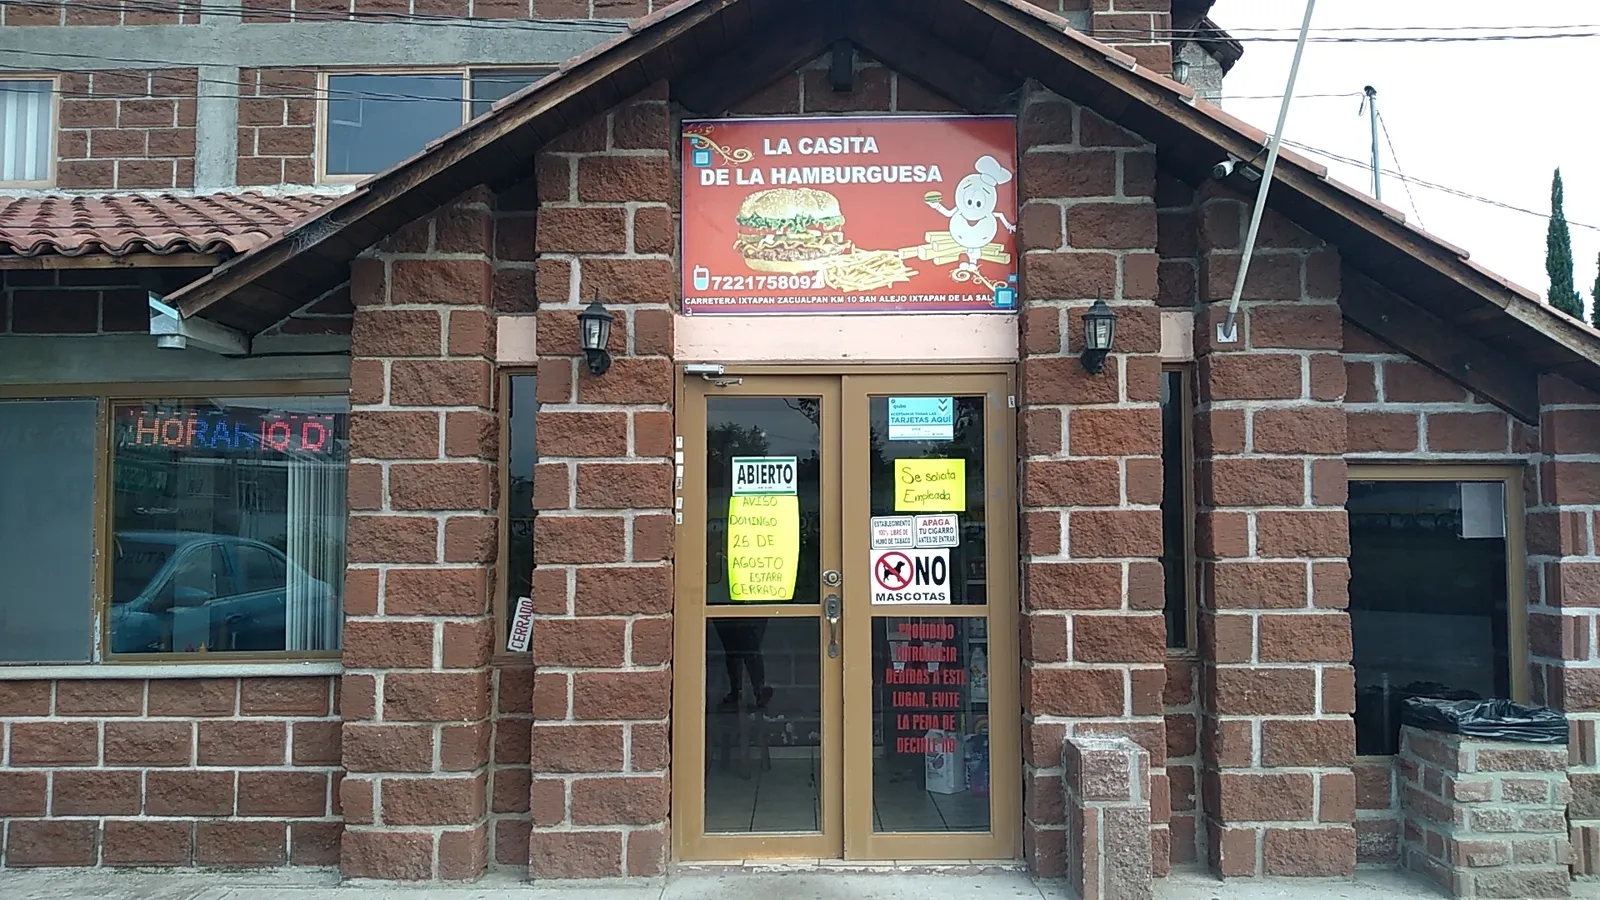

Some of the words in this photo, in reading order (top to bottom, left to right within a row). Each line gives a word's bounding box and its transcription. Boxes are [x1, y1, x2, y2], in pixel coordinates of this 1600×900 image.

[763, 138, 792, 155] LA
[798, 136, 879, 154] CASITA
[700, 168, 730, 186] DE
[736, 168, 765, 185] LA
[770, 165, 943, 185] HAMBURGUESA
[684, 297, 737, 305] CARRETERA
[738, 297, 775, 305] IXTAPAN
[777, 296, 828, 304] ZACUALPAN
[830, 296, 844, 304] KM
[846, 295, 857, 303] 10
[859, 295, 877, 303] SAN
[880, 294, 907, 302] ALEJO
[909, 294, 946, 302] IXTAPAN
[948, 294, 960, 302] DE
[890, 416, 929, 424] TARJETAS
[931, 414, 951, 424] AQUÍ
[737, 464, 793, 485] ABIERTO
[901, 466, 922, 485] Se
[742, 496, 778, 507] AVISO
[903, 488, 951, 506] Empleada
[729, 514, 778, 527] DOMINGO
[922, 518, 951, 526] APAGA
[733, 534, 750, 548] 25
[756, 534, 775, 548] DE
[938, 535, 955, 543] ENTRAR
[732, 556, 784, 570] AGOSTO
[915, 555, 946, 586] NO
[731, 582, 787, 598] CERRADO
[875, 592, 946, 601] MASCOTAS
[511, 600, 534, 649] CERRADO
[898, 623, 954, 639] PROHIBIDO
[886, 668, 929, 684] BEBIDAS
[932, 669, 940, 684] A
[943, 668, 967, 684] ESTE
[932, 691, 960, 707] EVITE
[896, 714, 909, 730] LA
[912, 714, 939, 730] PENA
[942, 714, 956, 730] DE
[896, 737, 938, 753] DECIRLE
[940, 736, 957, 753] NO
